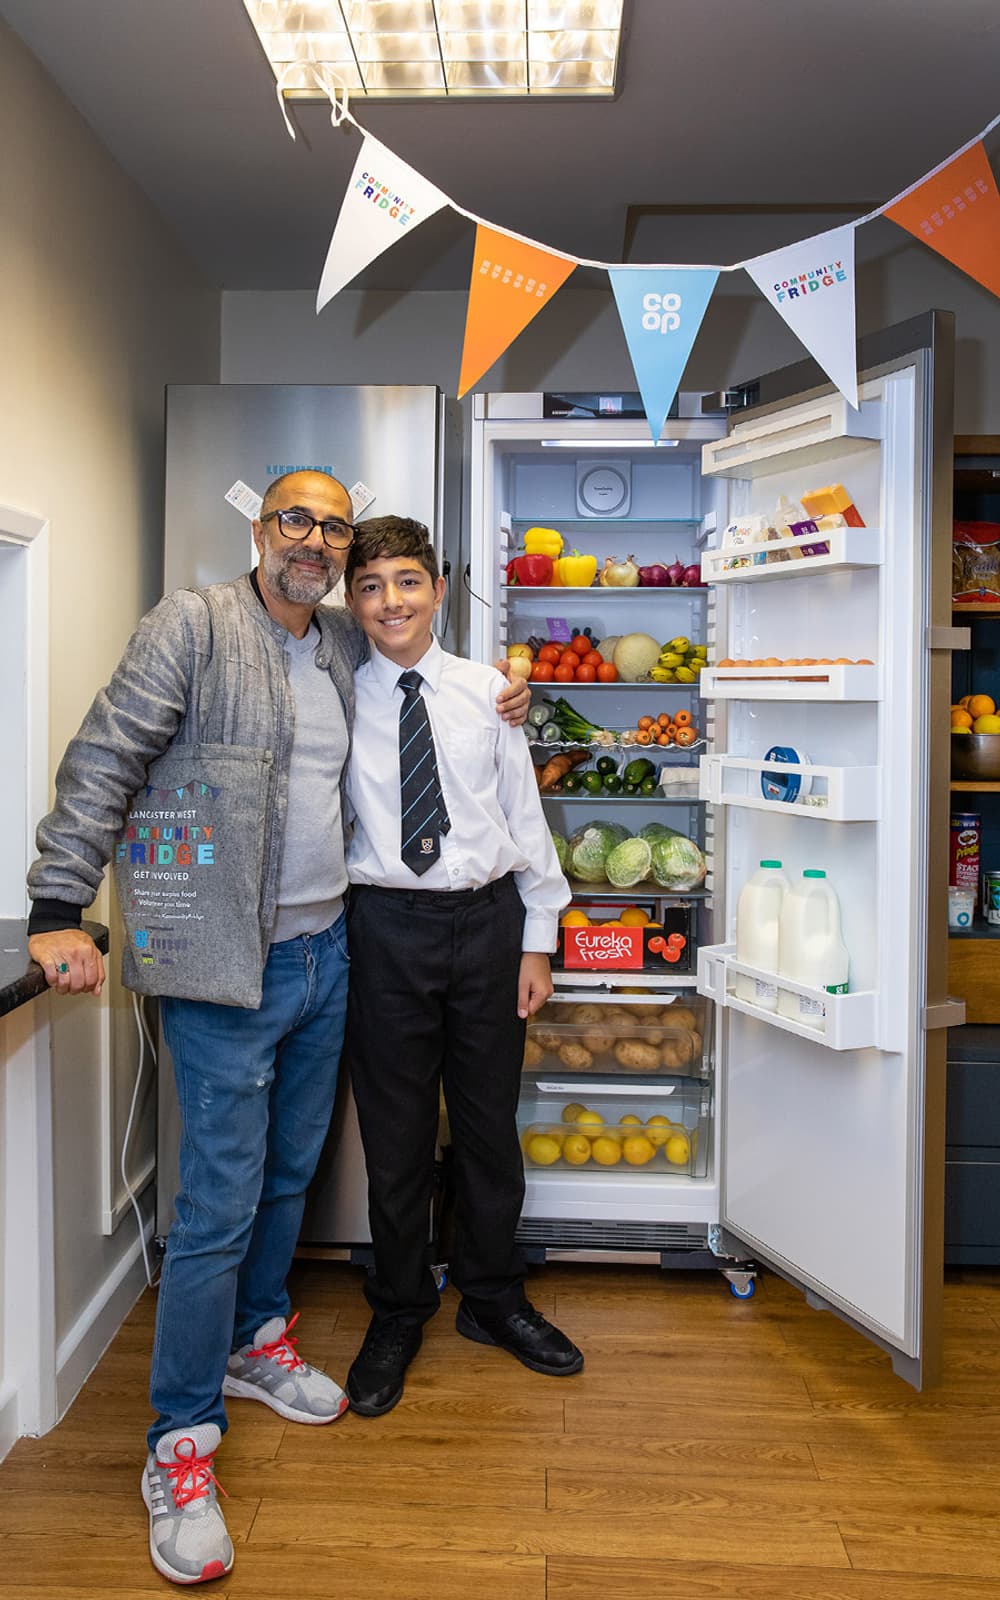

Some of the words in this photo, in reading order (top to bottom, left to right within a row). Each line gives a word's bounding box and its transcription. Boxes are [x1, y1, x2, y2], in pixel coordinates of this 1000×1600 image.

[362, 172, 415, 215] COMMUNITY
[355, 179, 410, 226] FRIDGE
[774, 261, 842, 291] COMMUNITY
[776, 270, 847, 303] FRIDGE
[129, 810, 175, 819] LANCASTER
[117, 826, 214, 841] OMMUNITY
[115, 843, 215, 865] FRIDGE
[133, 870, 150, 880] GET
[181, 889, 197, 898] food
[575, 931, 632, 948] Eureka
[580, 945, 632, 961] fresh
